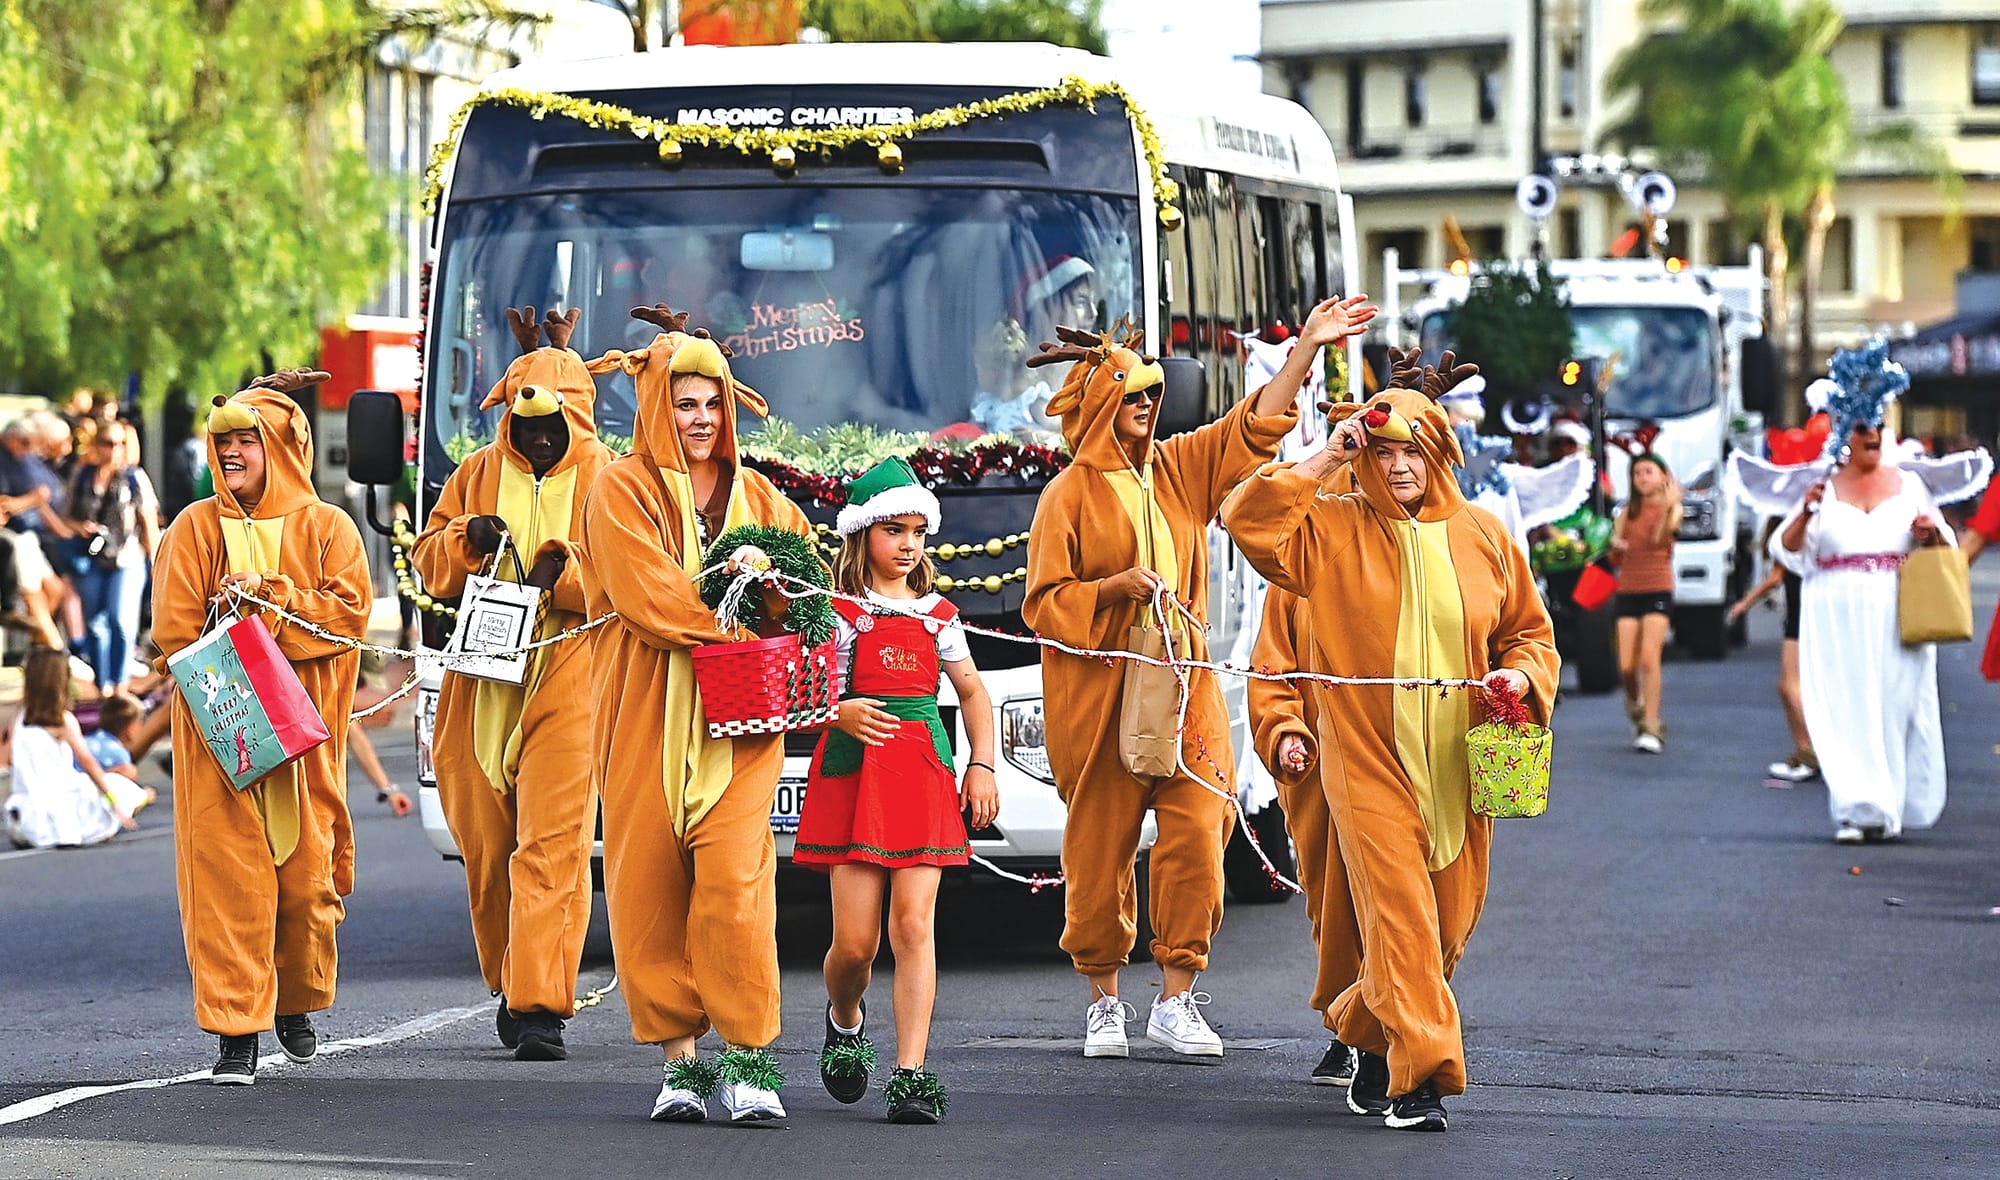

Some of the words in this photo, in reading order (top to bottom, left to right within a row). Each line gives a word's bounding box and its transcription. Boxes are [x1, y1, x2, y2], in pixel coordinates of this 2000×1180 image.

[677, 108, 784, 125] MASONIC
[790, 107, 914, 125] CHARITIES
[744, 299, 841, 331] Merry
[723, 318, 865, 361] Christmas
[210, 705, 249, 735] CHRISTMAS
[211, 696, 238, 719] MERRY
